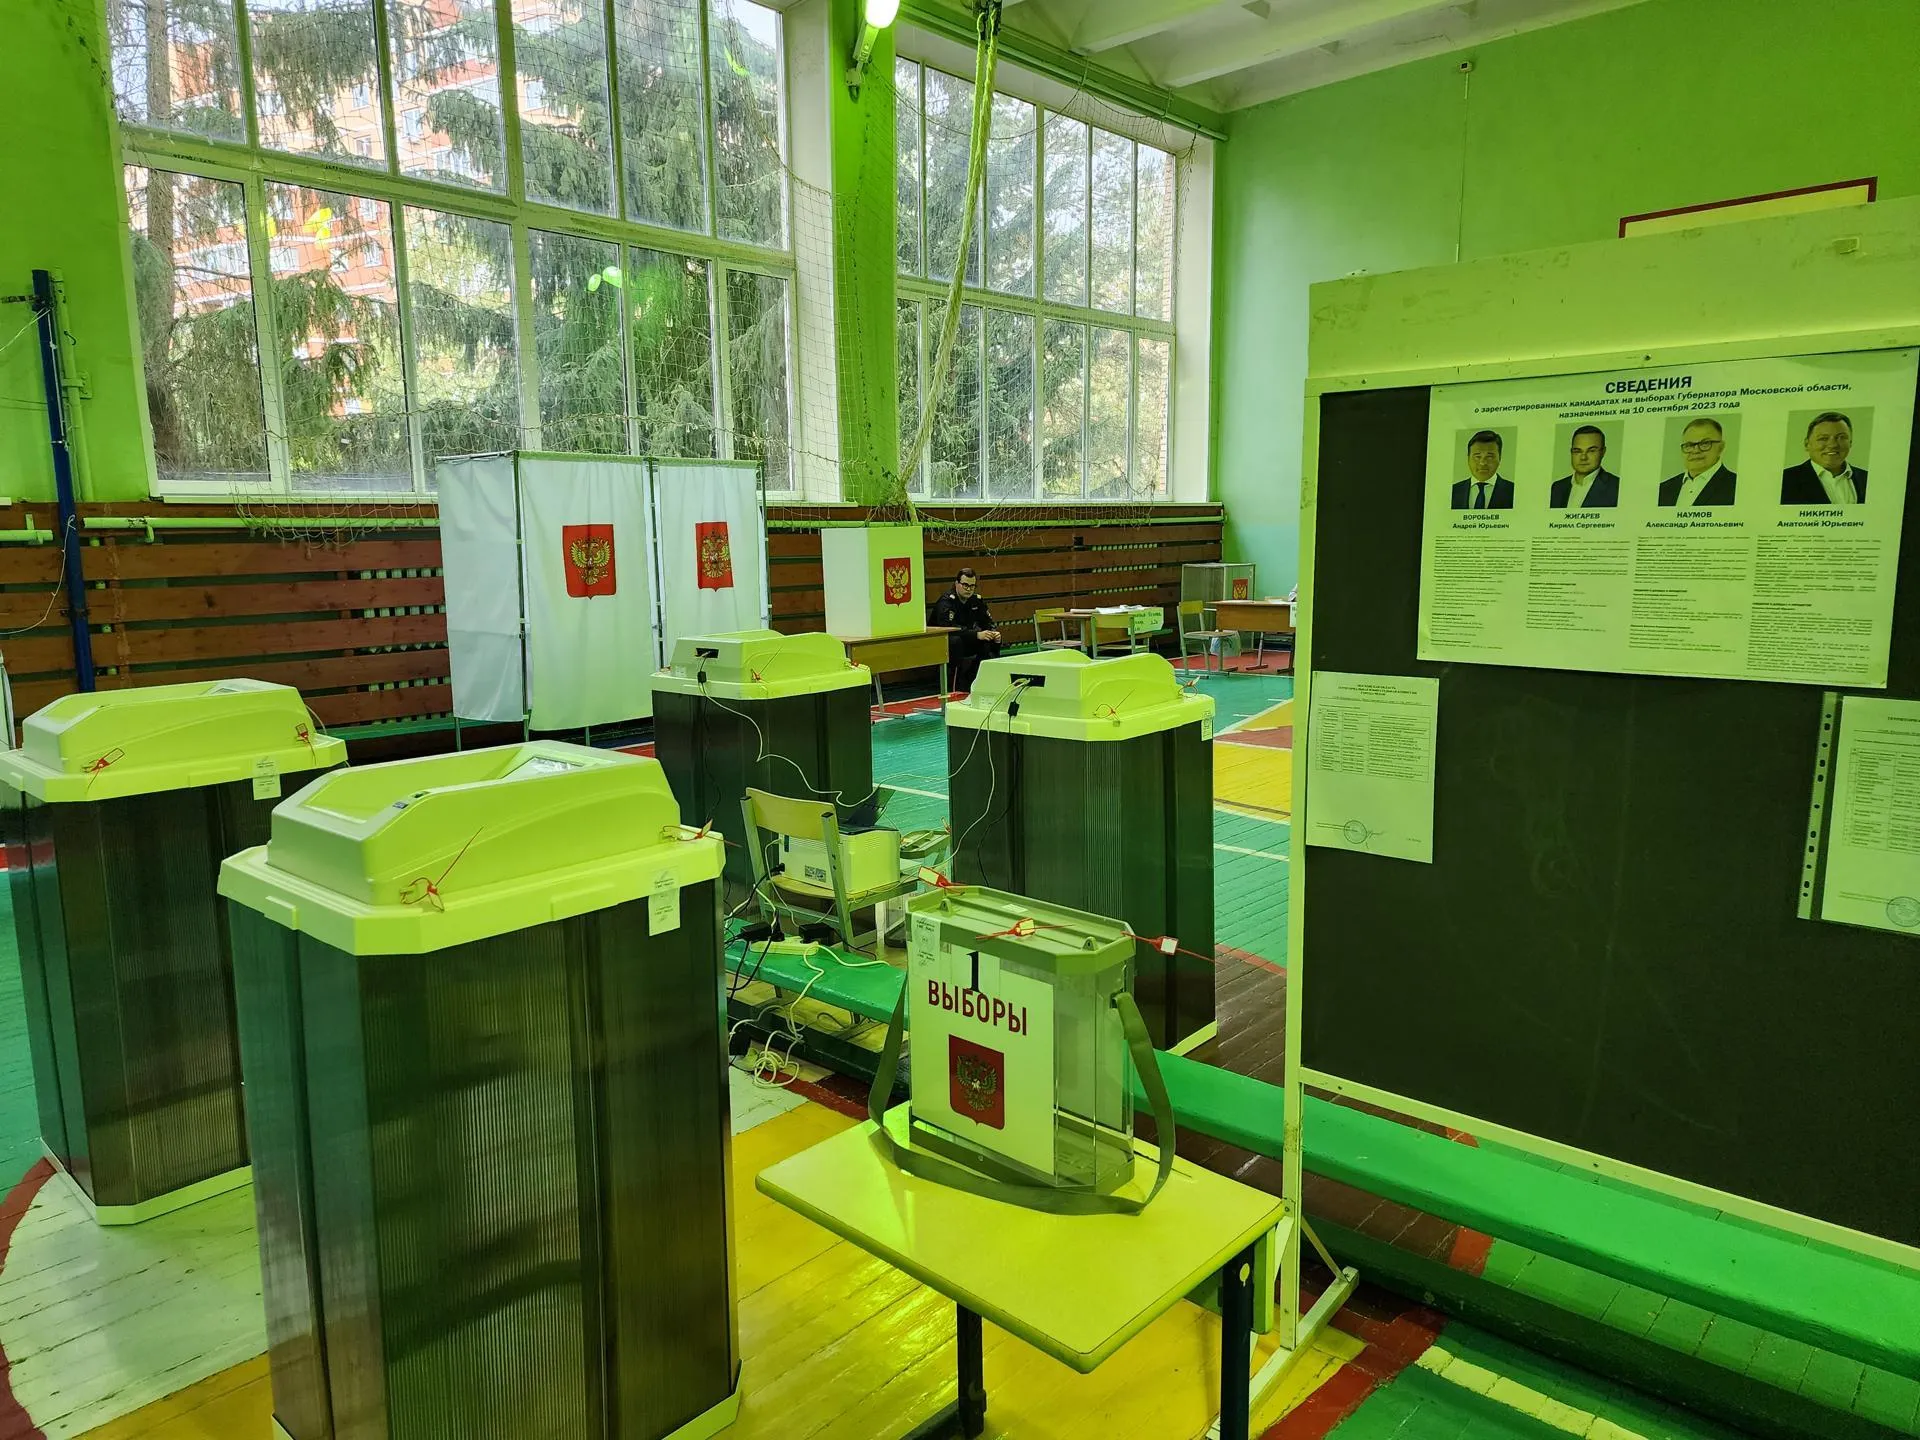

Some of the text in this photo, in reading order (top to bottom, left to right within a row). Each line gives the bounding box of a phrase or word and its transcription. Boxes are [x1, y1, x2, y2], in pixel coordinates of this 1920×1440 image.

[1605, 376, 1692, 393] СВЕДЕНИЯ
[1481, 401, 1568, 414] зарегистрированных
[1569, 397, 1620, 407] кандидатах
[1635, 394, 1675, 403] выборах
[1677, 390, 1737, 401] Губернатора
[1740, 385, 1804, 396] Московской
[1806, 383, 1852, 393] области,
[1559, 409, 1617, 419] назначенных
[1633, 406, 1645, 414] 10
[1646, 403, 1689, 414] сентября
[1691, 402, 1716, 410] 2023
[1718, 401, 1741, 409] года
[1549, 522, 1615, 530] Кирилл Сергеевич
[1646, 521, 1689, 529] Александр
[1821, 520, 1865, 528] Юрьевич
[966, 951, 980, 993] 1
[928, 979, 1028, 1036] ВЫБОРЫ
